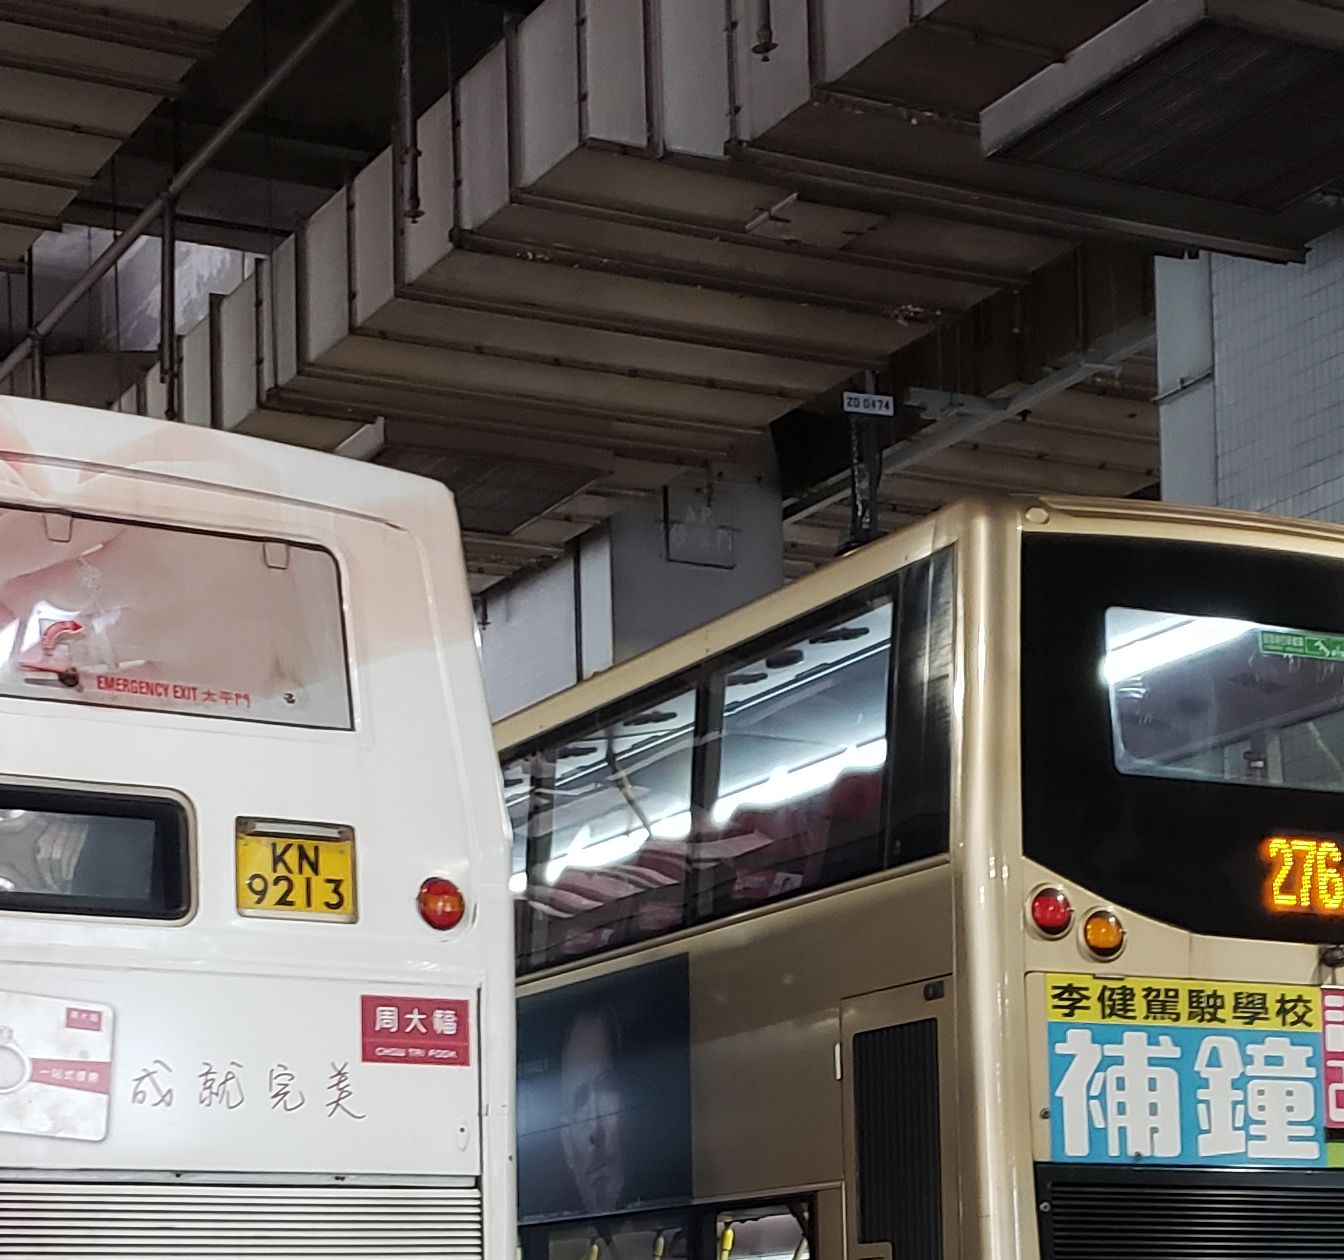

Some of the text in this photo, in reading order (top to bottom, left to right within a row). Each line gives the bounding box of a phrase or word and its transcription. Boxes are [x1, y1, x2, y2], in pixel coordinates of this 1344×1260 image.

[96, 675, 251, 708] EMERGENCY EXIT 太平門
[271, 842, 320, 876] KN
[246, 873, 344, 910] 9213
[374, 1006, 458, 1035] 周大福
[1051, 983, 1315, 1029] 李健駕駛學校
[131, 1060, 367, 1119] 成就完美
[1054, 1028, 1321, 1160] 補鐘
